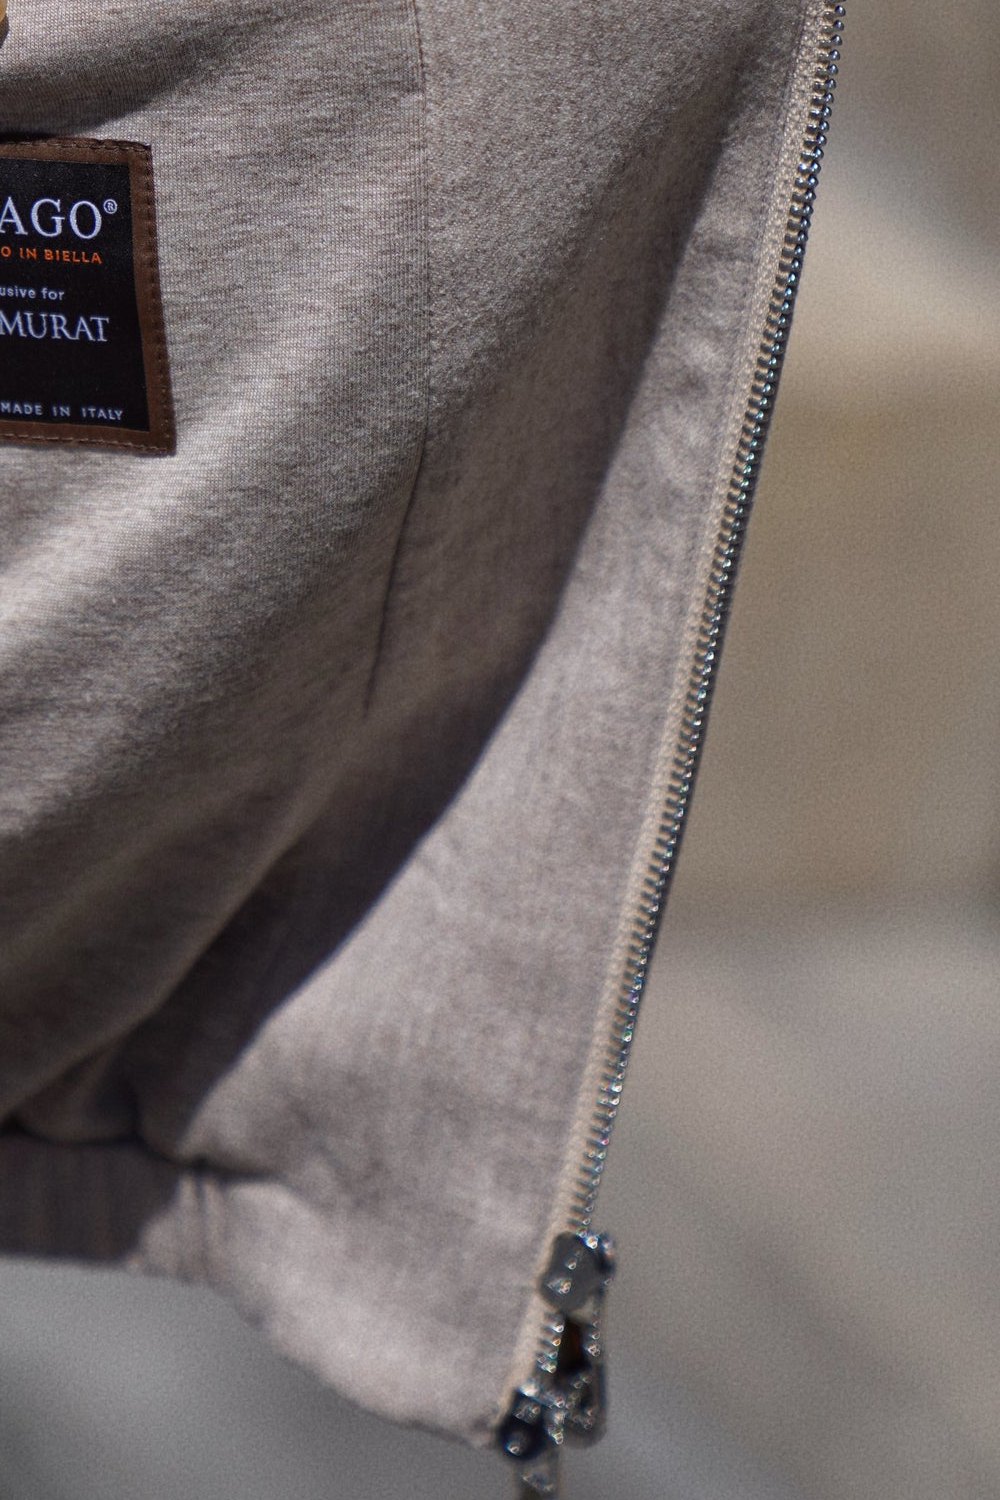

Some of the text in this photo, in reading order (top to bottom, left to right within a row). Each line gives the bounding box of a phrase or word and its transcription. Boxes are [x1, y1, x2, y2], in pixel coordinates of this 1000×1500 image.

[19, 248, 37, 260] IN
[44, 249, 102, 264] BIELLA
[41, 287, 65, 301] for
[0, 403, 43, 416] MADE
[52, 406, 70, 418] IN
[81, 407, 123, 421] ITALY
